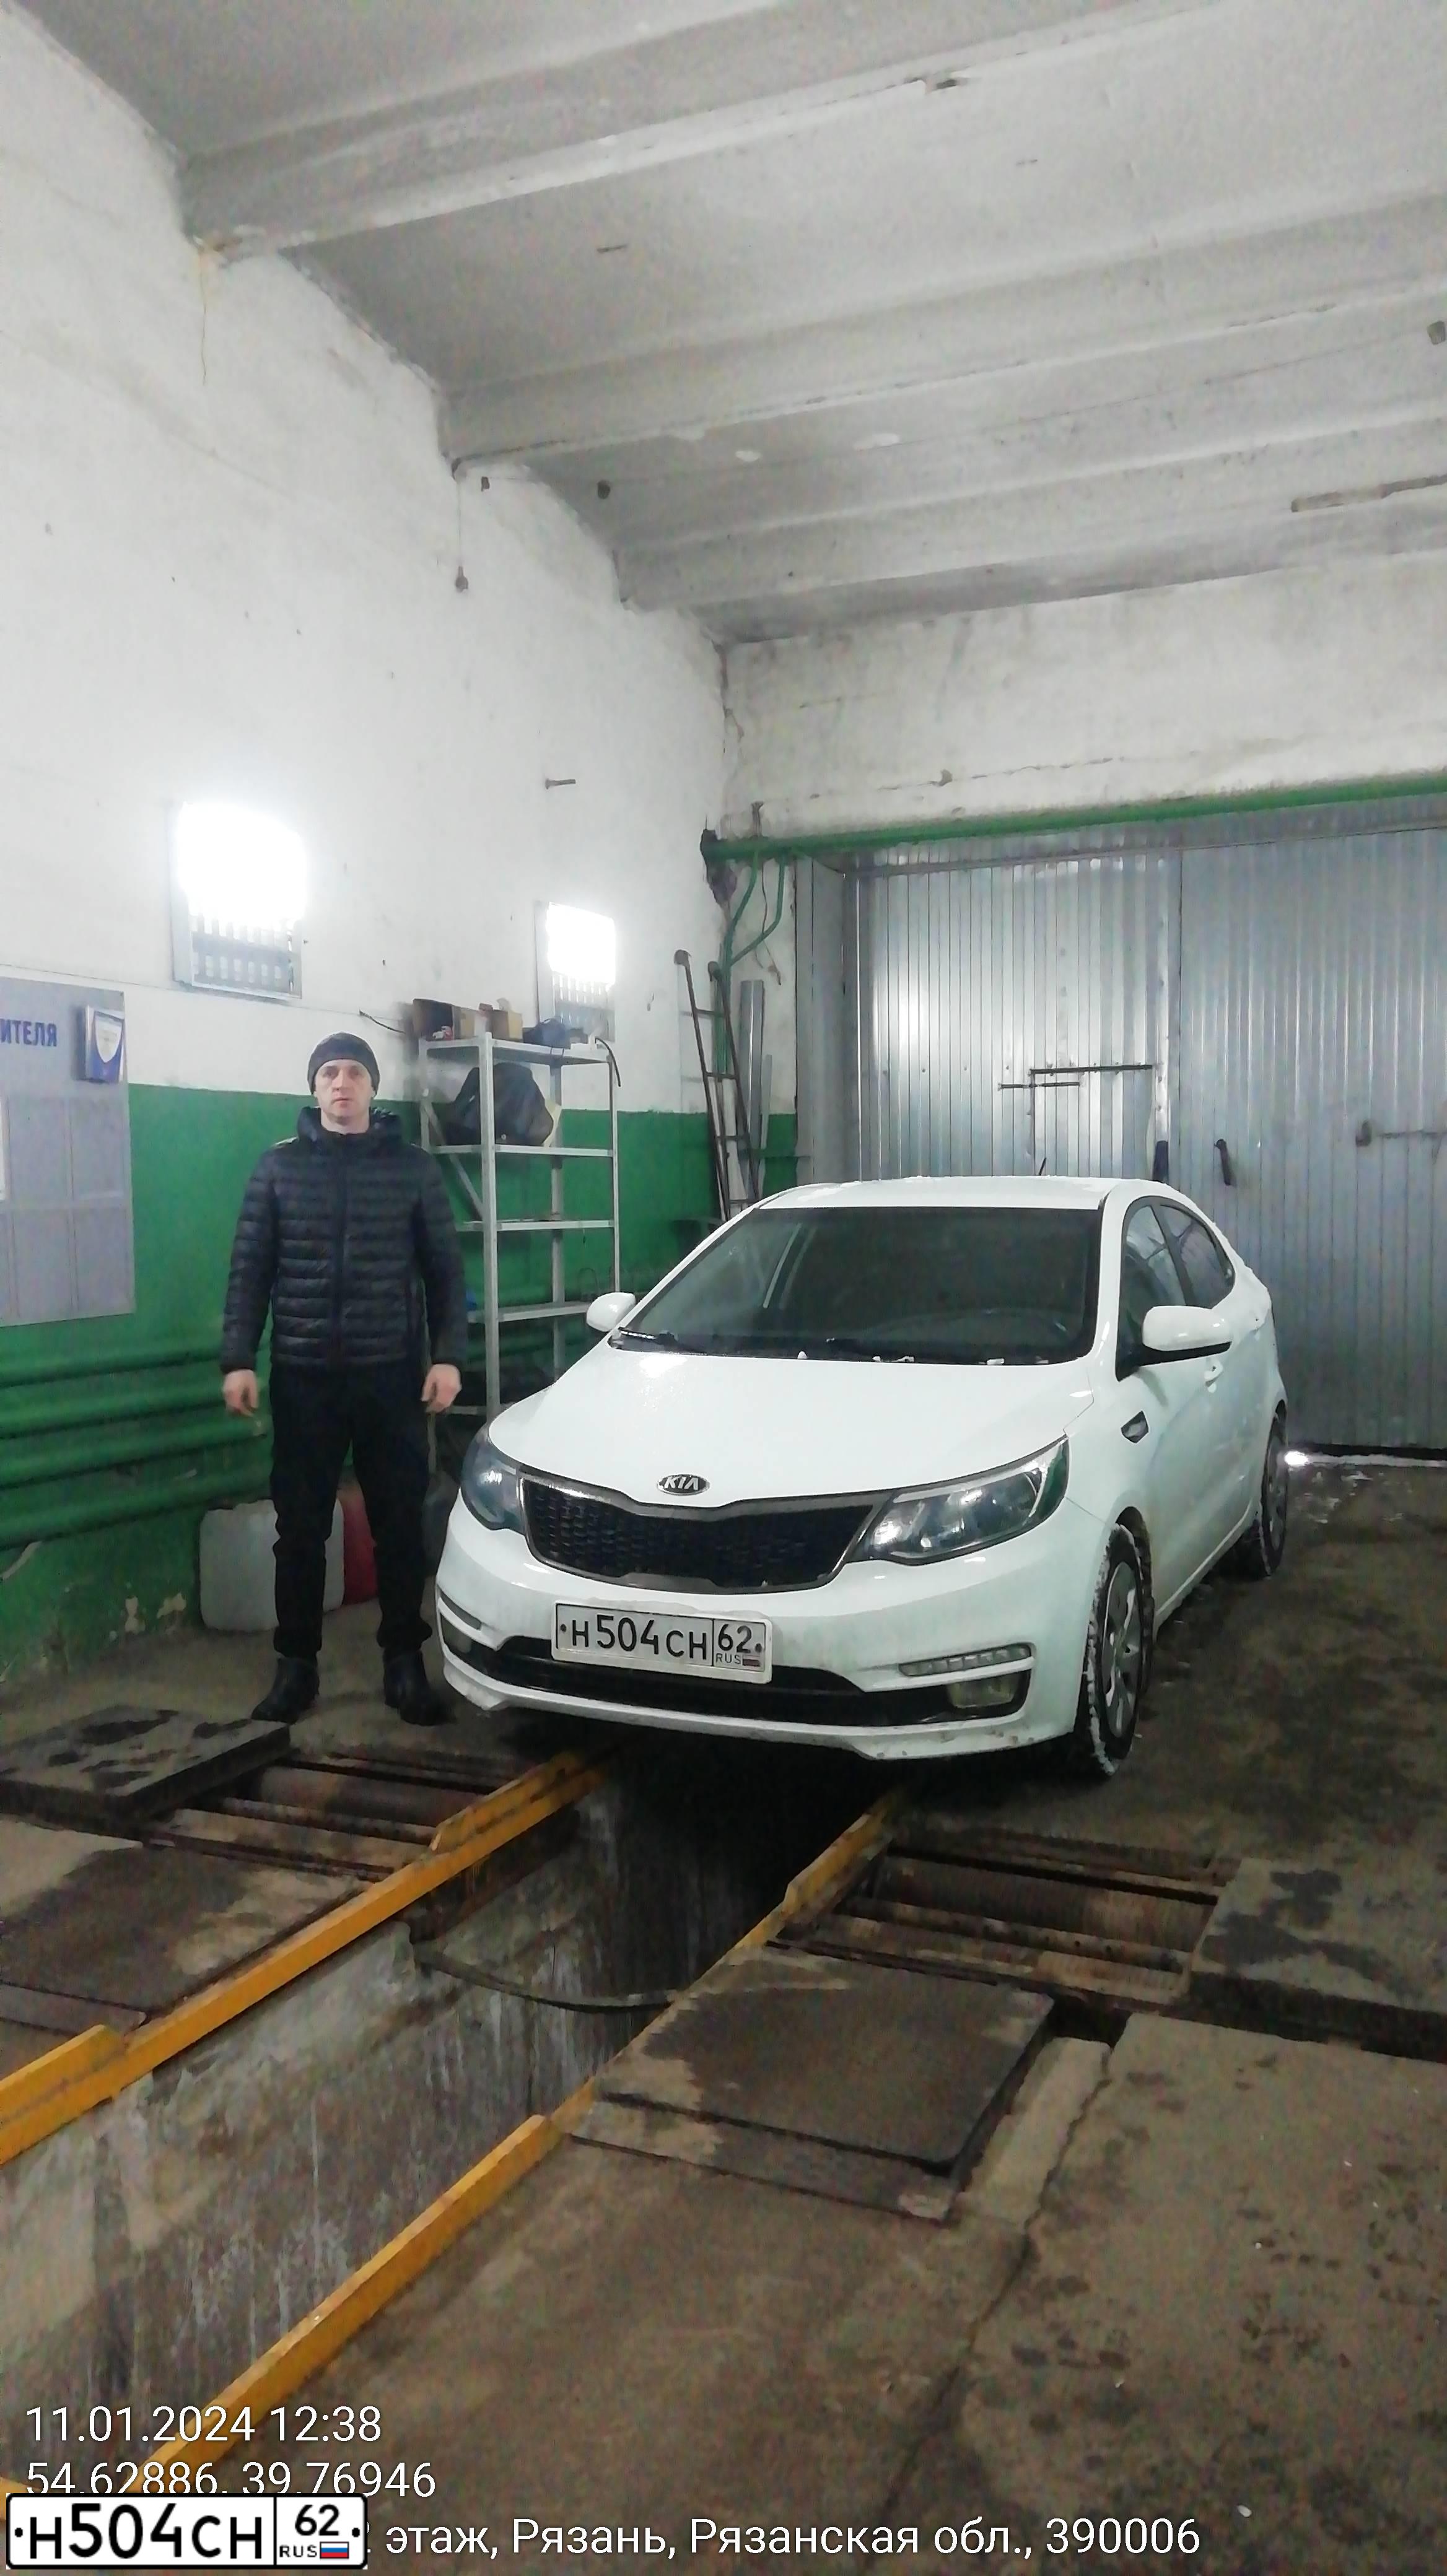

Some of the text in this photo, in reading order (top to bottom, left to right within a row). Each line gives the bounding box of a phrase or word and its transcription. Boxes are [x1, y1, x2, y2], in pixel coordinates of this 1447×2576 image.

[663, 1476, 699, 1490] KIA
[717, 1624, 752, 1654] 62
[715, 1653, 741, 1664] RUS
